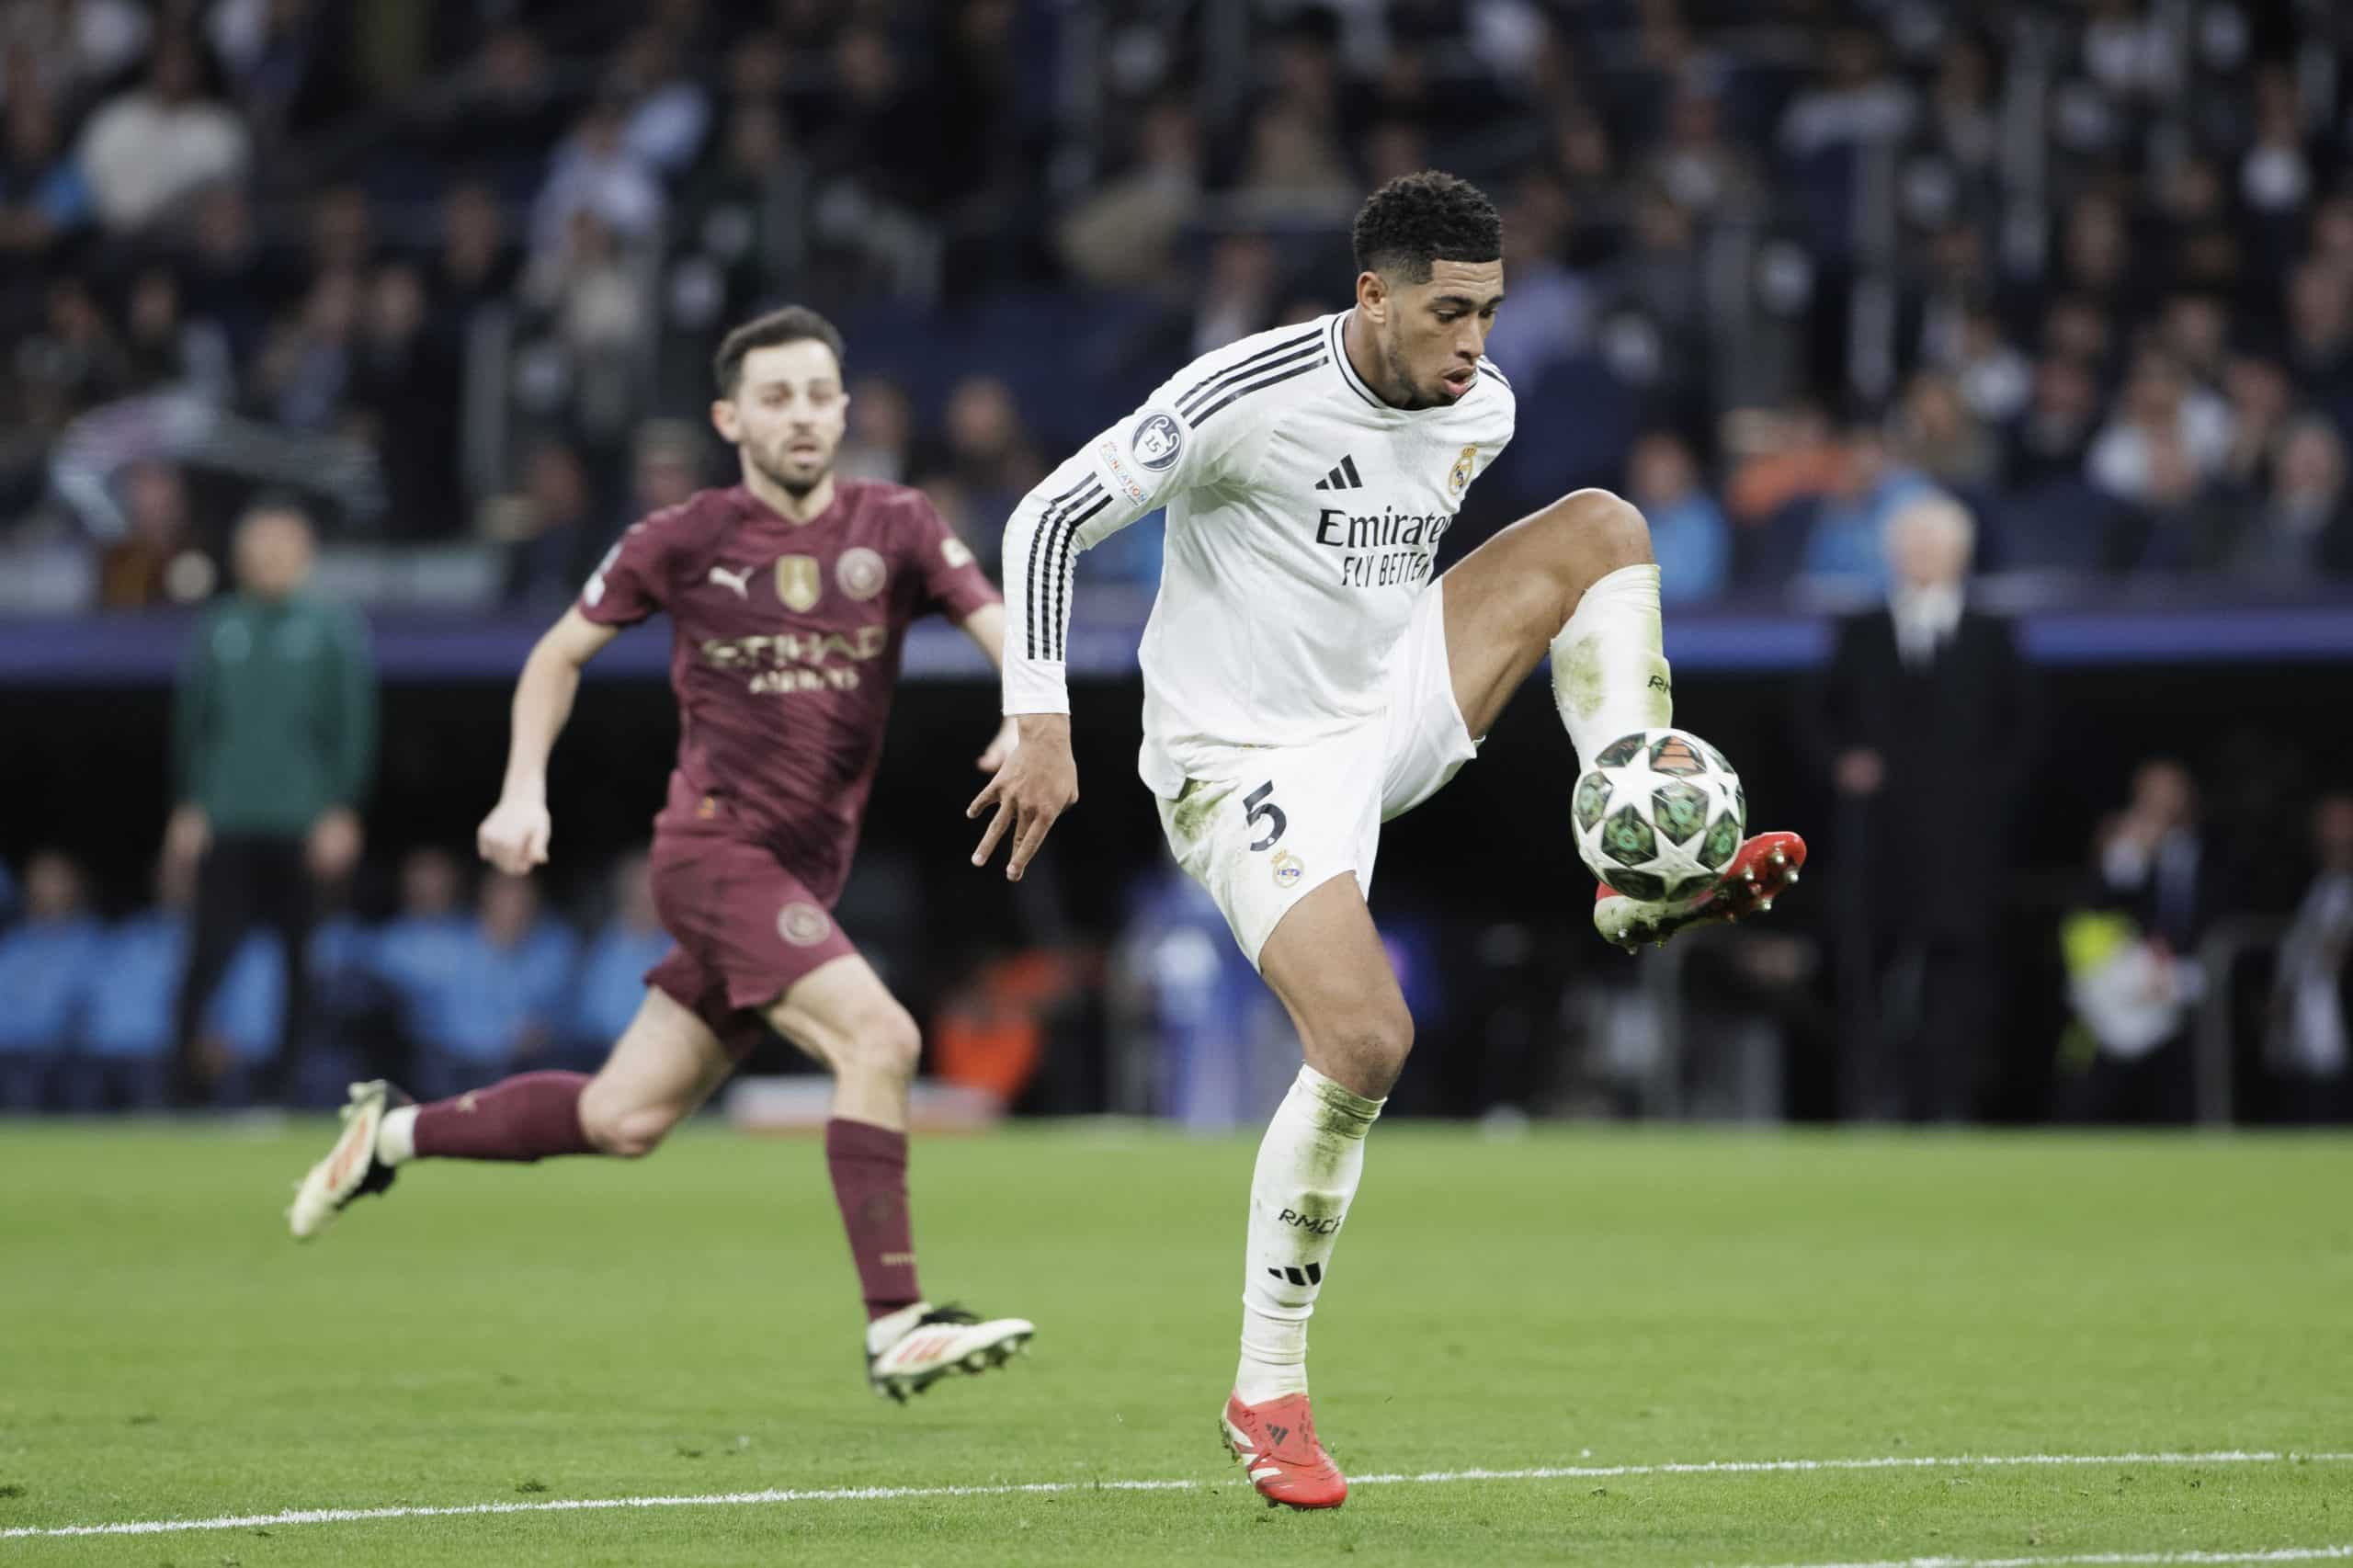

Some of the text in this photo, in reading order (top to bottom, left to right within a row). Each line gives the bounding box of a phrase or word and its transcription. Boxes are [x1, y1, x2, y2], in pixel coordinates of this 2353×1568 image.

[1145, 435, 1162, 452] 15
[1342, 556, 1374, 587] FLY
[1243, 779, 1287, 851] 5
